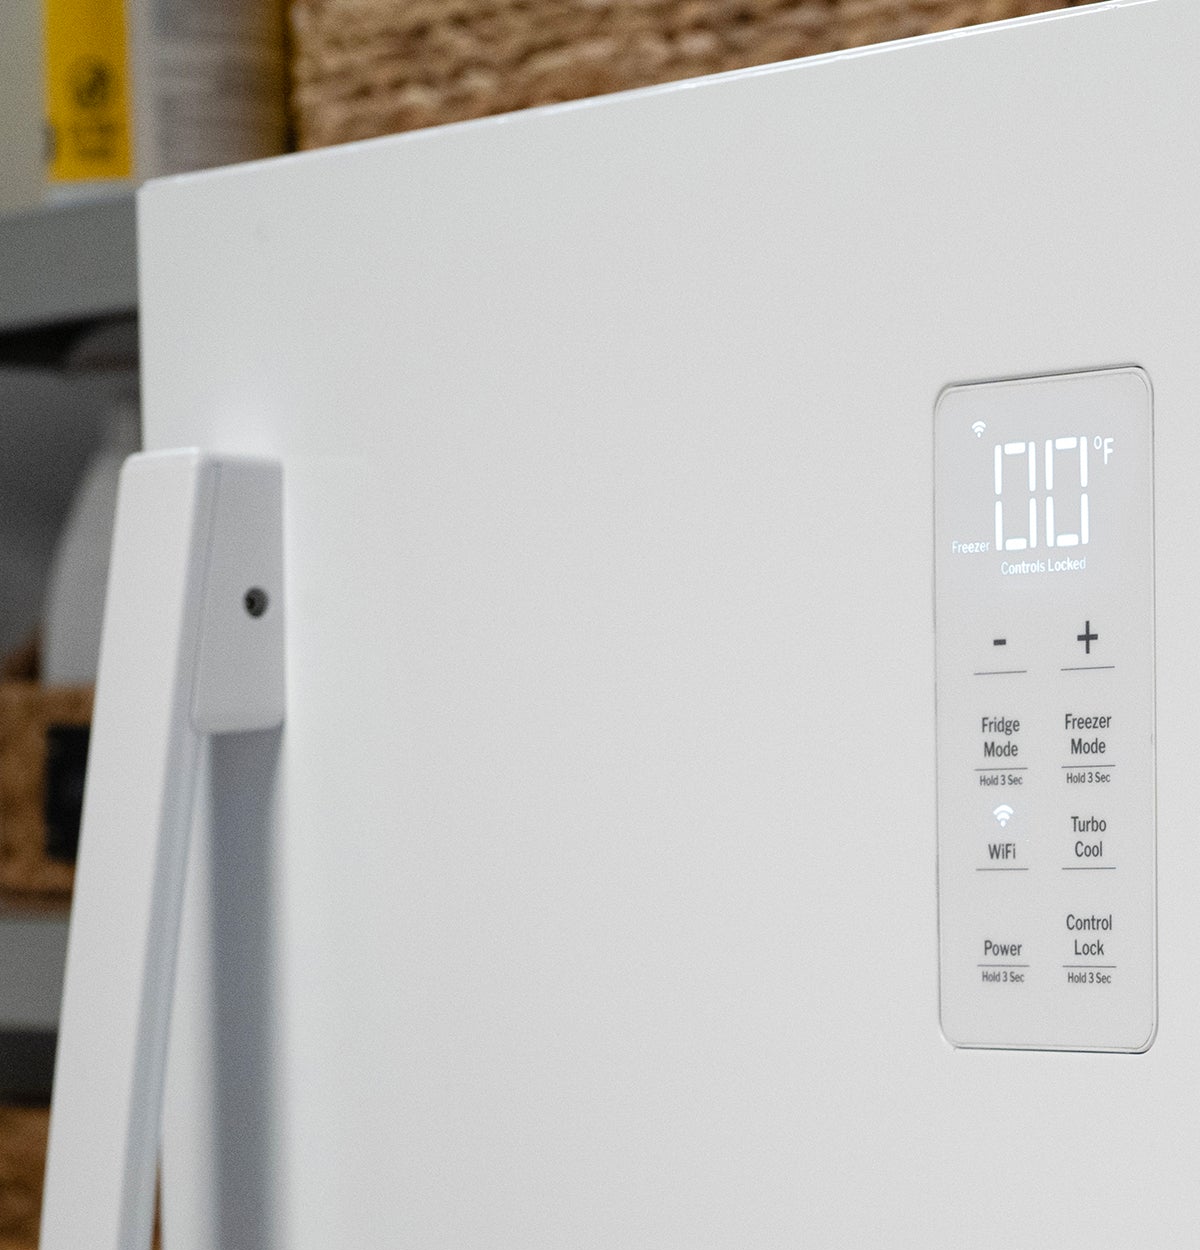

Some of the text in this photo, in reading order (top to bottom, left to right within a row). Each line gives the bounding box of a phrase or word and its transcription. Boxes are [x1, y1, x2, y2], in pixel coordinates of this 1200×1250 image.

[951, 540, 991, 554] Freezer
[1000, 556, 1087, 576] Controls Locked
[981, 716, 1021, 736] Fridge
[1064, 713, 1112, 730] Freezer
[983, 741, 1019, 757] Mode
[1070, 738, 1106, 754] Mode
[979, 774, 1023, 786] Hold 3 Sec
[1066, 771, 1111, 784] Hold 3 Sec
[1070, 816, 1107, 833] Turbo
[988, 843, 1016, 860] WiFi
[1074, 841, 1103, 857] Cool
[1066, 914, 1112, 931] Control
[984, 940, 1022, 956] Power
[1074, 939, 1105, 956] Lock
[982, 971, 1025, 983] Hold 3 Sec
[1067, 972, 1112, 984] Hold 3 Sec
